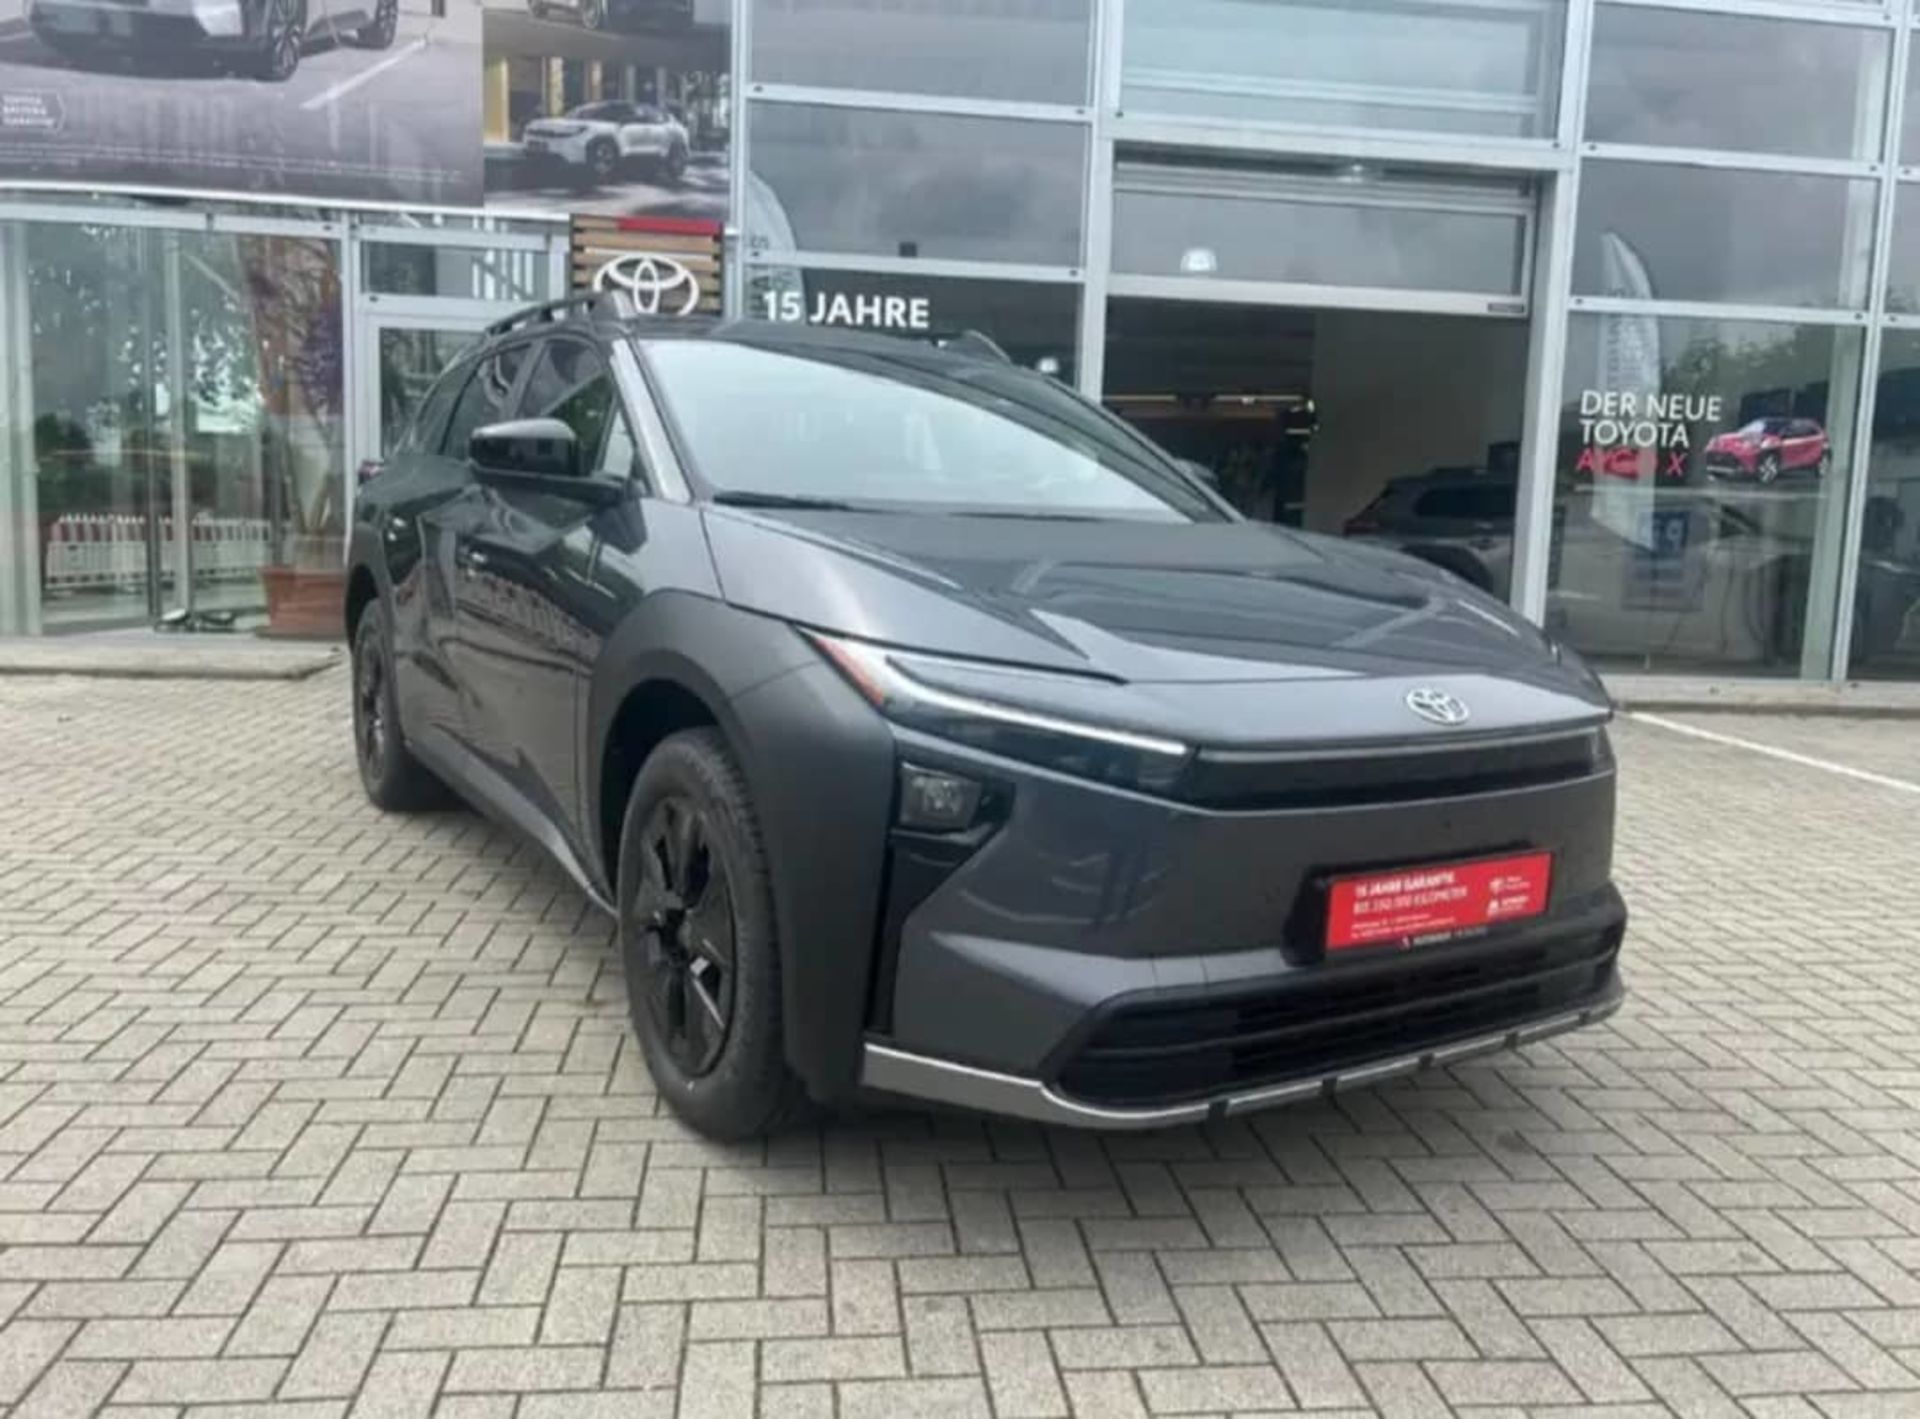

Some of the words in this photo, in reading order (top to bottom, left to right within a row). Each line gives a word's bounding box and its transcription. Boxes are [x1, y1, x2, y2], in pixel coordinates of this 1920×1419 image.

[763, 290, 800, 321] 15
[809, 291, 929, 329] JAHRE
[1580, 390, 1637, 417] DER
[1646, 393, 1722, 421] NEUE
[1579, 418, 1690, 448] TOYOTA
